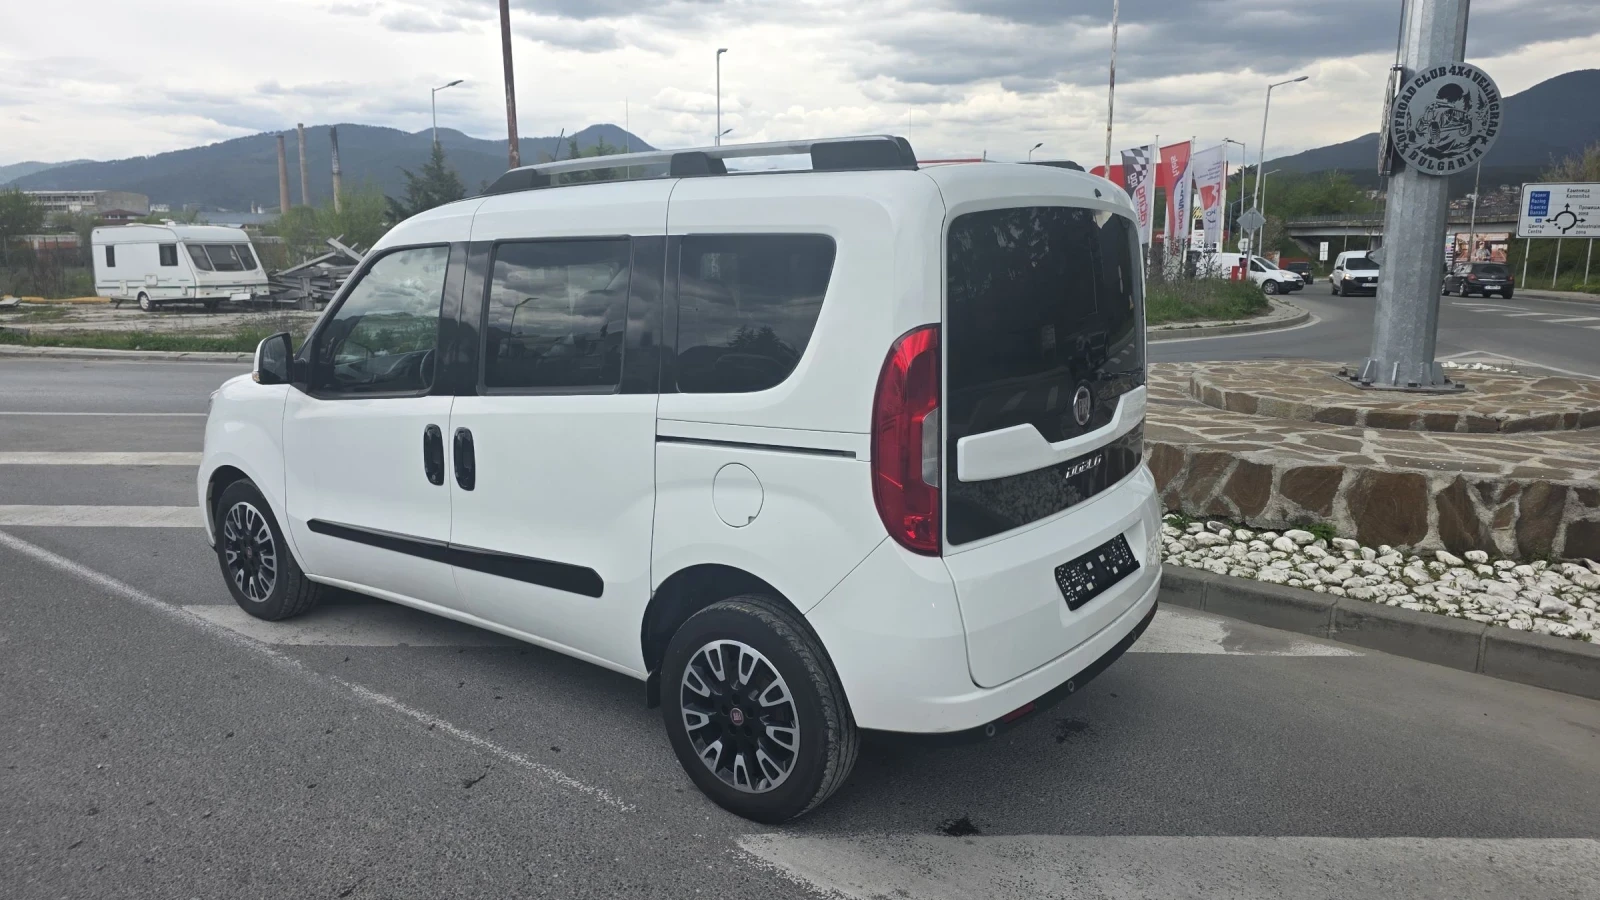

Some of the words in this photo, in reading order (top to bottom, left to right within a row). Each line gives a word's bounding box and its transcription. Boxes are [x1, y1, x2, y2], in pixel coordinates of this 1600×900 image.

[1394, 86, 1417, 143] OFFROAD
[1414, 66, 1447, 88] CLUB
[1449, 65, 1473, 79] 4X4
[1472, 72, 1500, 137] VELINGRAD
[1408, 147, 1482, 171] BULGARIA
